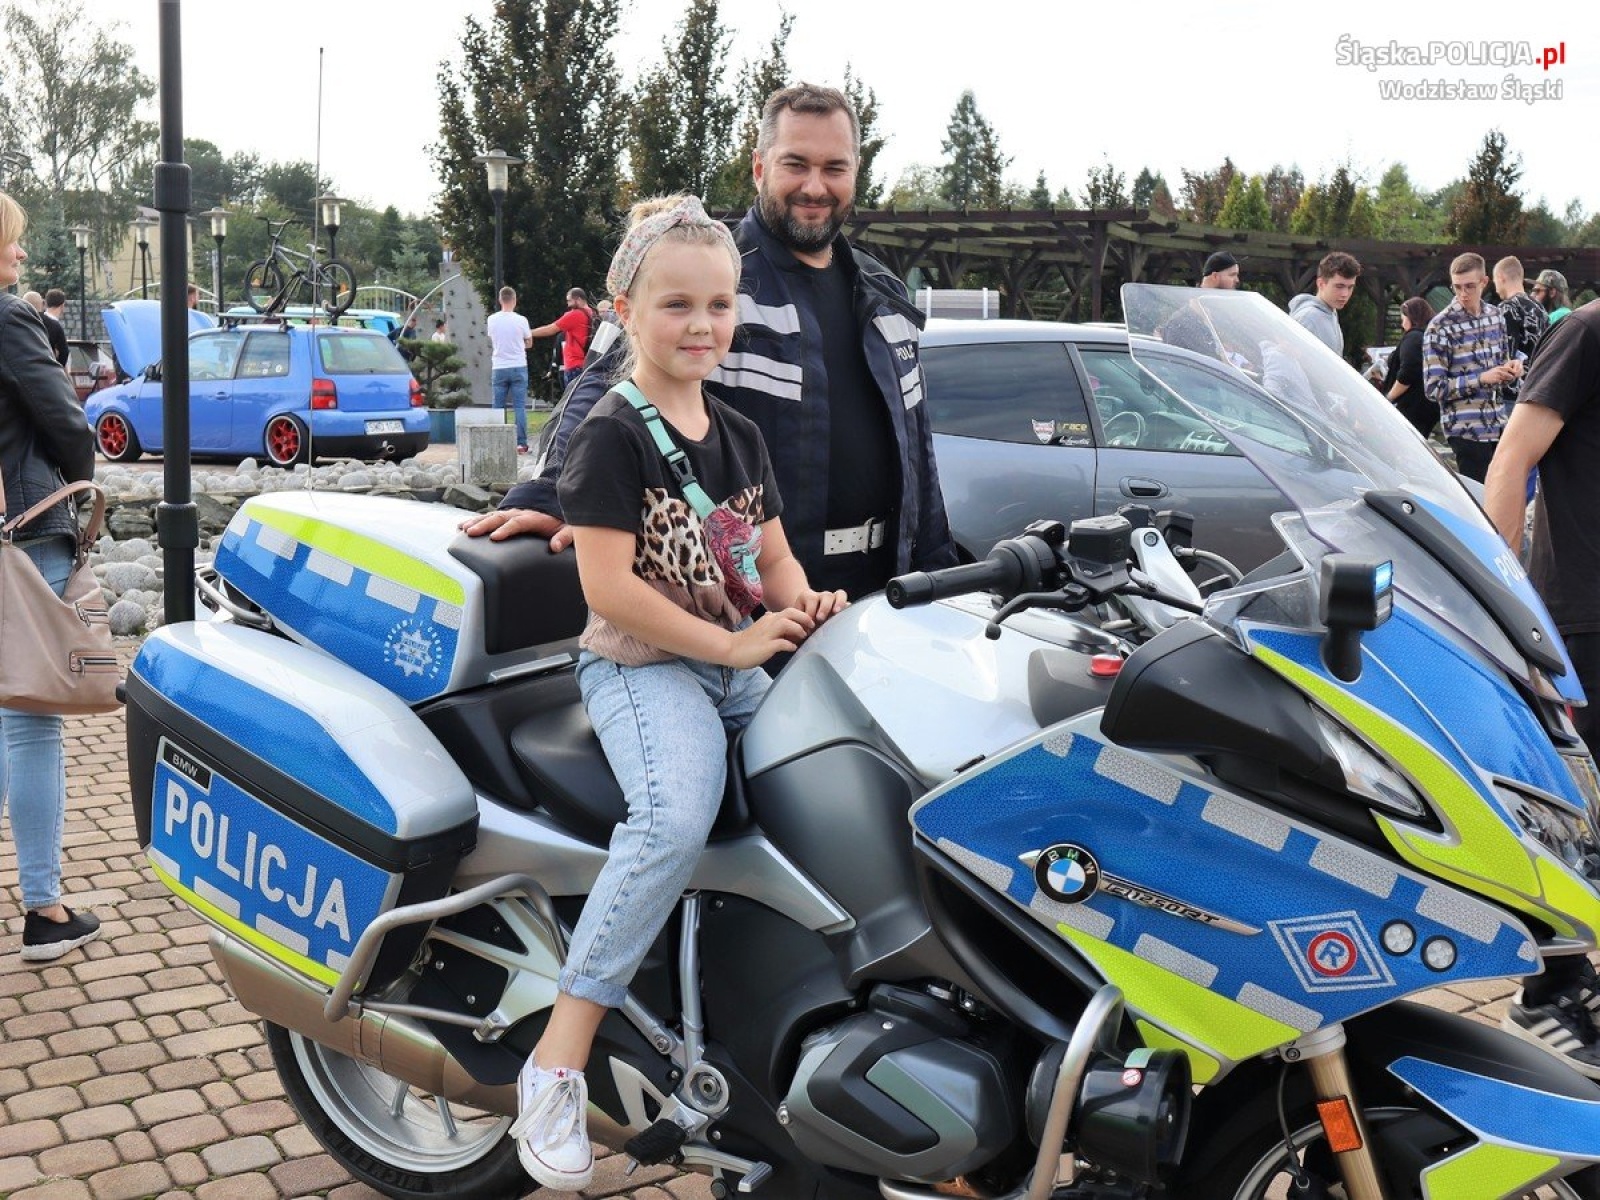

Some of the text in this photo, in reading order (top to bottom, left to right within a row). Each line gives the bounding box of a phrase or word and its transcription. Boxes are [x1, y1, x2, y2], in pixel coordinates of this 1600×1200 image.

[172, 752, 198, 778] BMW
[164, 778, 350, 943] POLICJA
[1317, 940, 1345, 968] R
